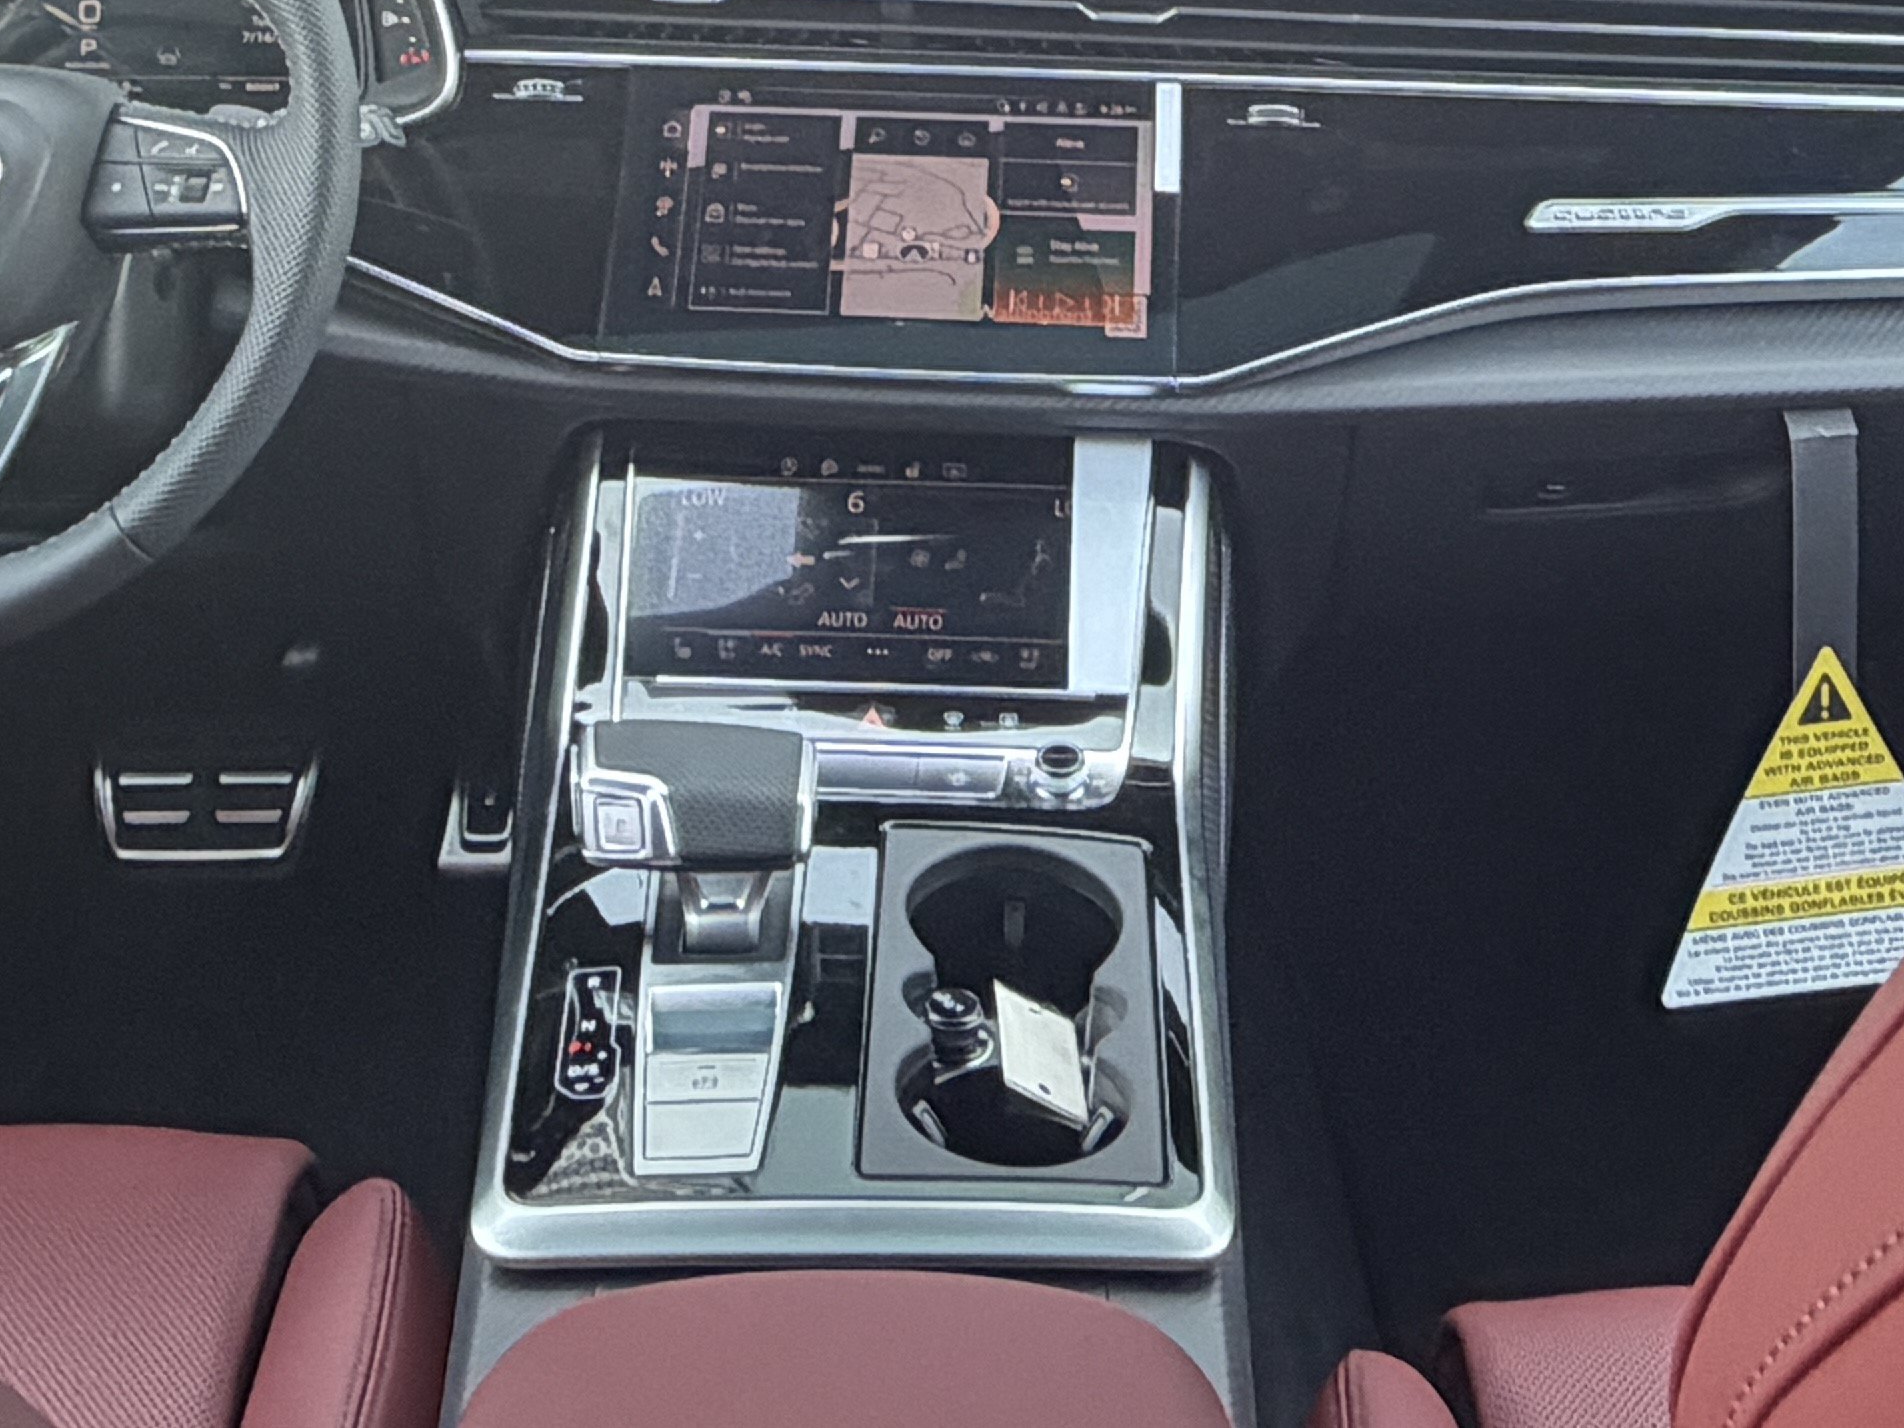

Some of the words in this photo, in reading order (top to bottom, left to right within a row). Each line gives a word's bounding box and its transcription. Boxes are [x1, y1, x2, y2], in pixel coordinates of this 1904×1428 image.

[242, 30, 277, 43] 7/16/
[80, 38, 97, 57] P
[848, 490, 865, 514] 6
[817, 611, 868, 628] AUTO
[893, 613, 944, 631] AUTO
[760, 643, 783, 657] A/C
[798, 644, 833, 658] SYNC
[927, 646, 953, 662] OFF
[1779, 733, 1810, 746] THIS
[1813, 726, 1870, 742] VEHICLE
[1797, 741, 1869, 760] EQUIPPED
[1764, 763, 1802, 778] WITH
[1805, 752, 1886, 772] ADVANCED
[1790, 775, 1814, 788] AIR
[1818, 769, 1861, 786] BAGS
[1827, 786, 1891, 802] ADVANCED
[1750, 880, 1822, 903] VÉHICULE
[1708, 901, 1786, 924] COUSSINS
[1788, 891, 1886, 914] GONFLABLES
[580, 1019, 596, 1033] N
